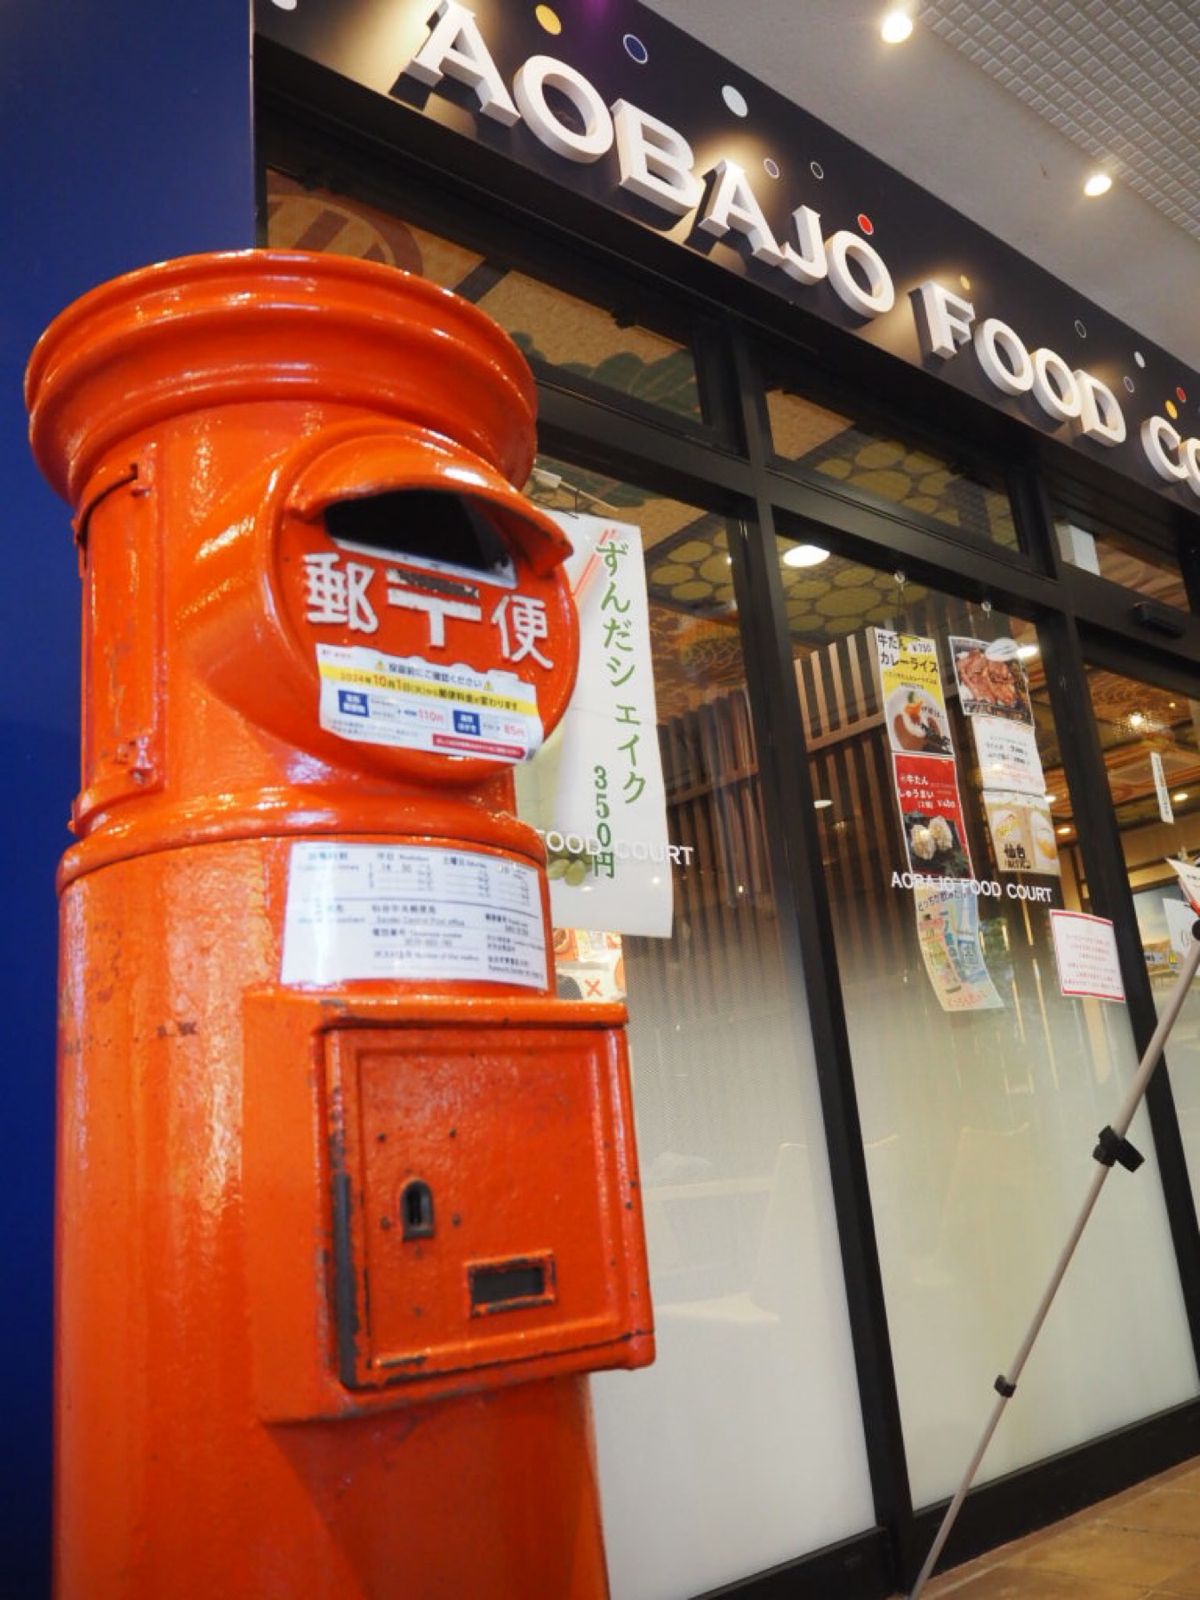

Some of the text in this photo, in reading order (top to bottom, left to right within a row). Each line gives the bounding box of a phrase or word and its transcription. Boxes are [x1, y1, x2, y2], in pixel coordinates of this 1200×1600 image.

[404, 0, 896, 319] AOBAJO
[909, 280, 1127, 448] FOOD
[596, 541, 646, 804] ずんだシェイク
[593, 765, 616, 879] 350円
[614, 839, 694, 866] COURT
[960, 879, 1002, 898] FOOD
[1005, 883, 1053, 903] COURT
